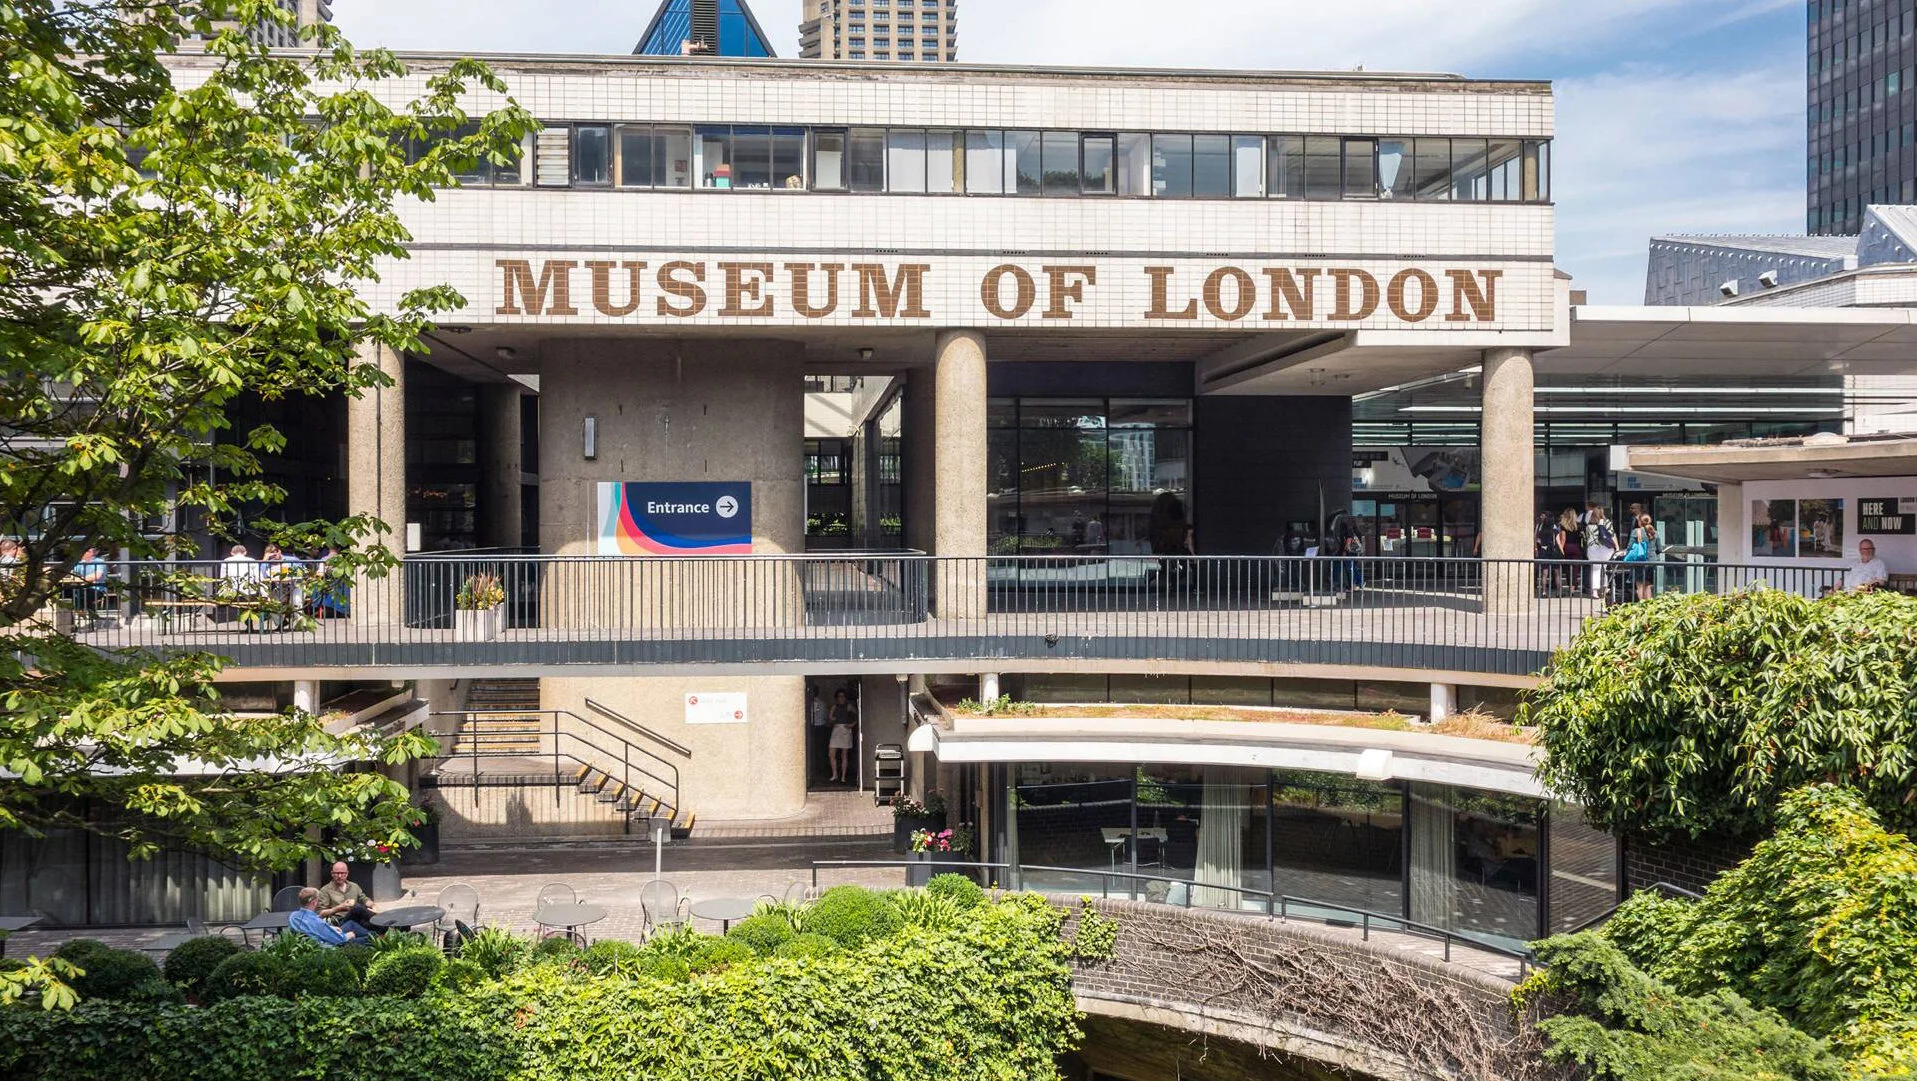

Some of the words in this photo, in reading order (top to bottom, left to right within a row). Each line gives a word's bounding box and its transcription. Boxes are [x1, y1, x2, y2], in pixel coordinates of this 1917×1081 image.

[495, 259, 931, 318] MUSEUM
[980, 263, 1096, 320] OF
[1144, 265, 1503, 323] LONDON
[647, 501, 710, 514] Entrance
[1863, 502, 1884, 515] HERE
[1863, 516, 1879, 530] AND
[1881, 516, 1902, 530] NOW
